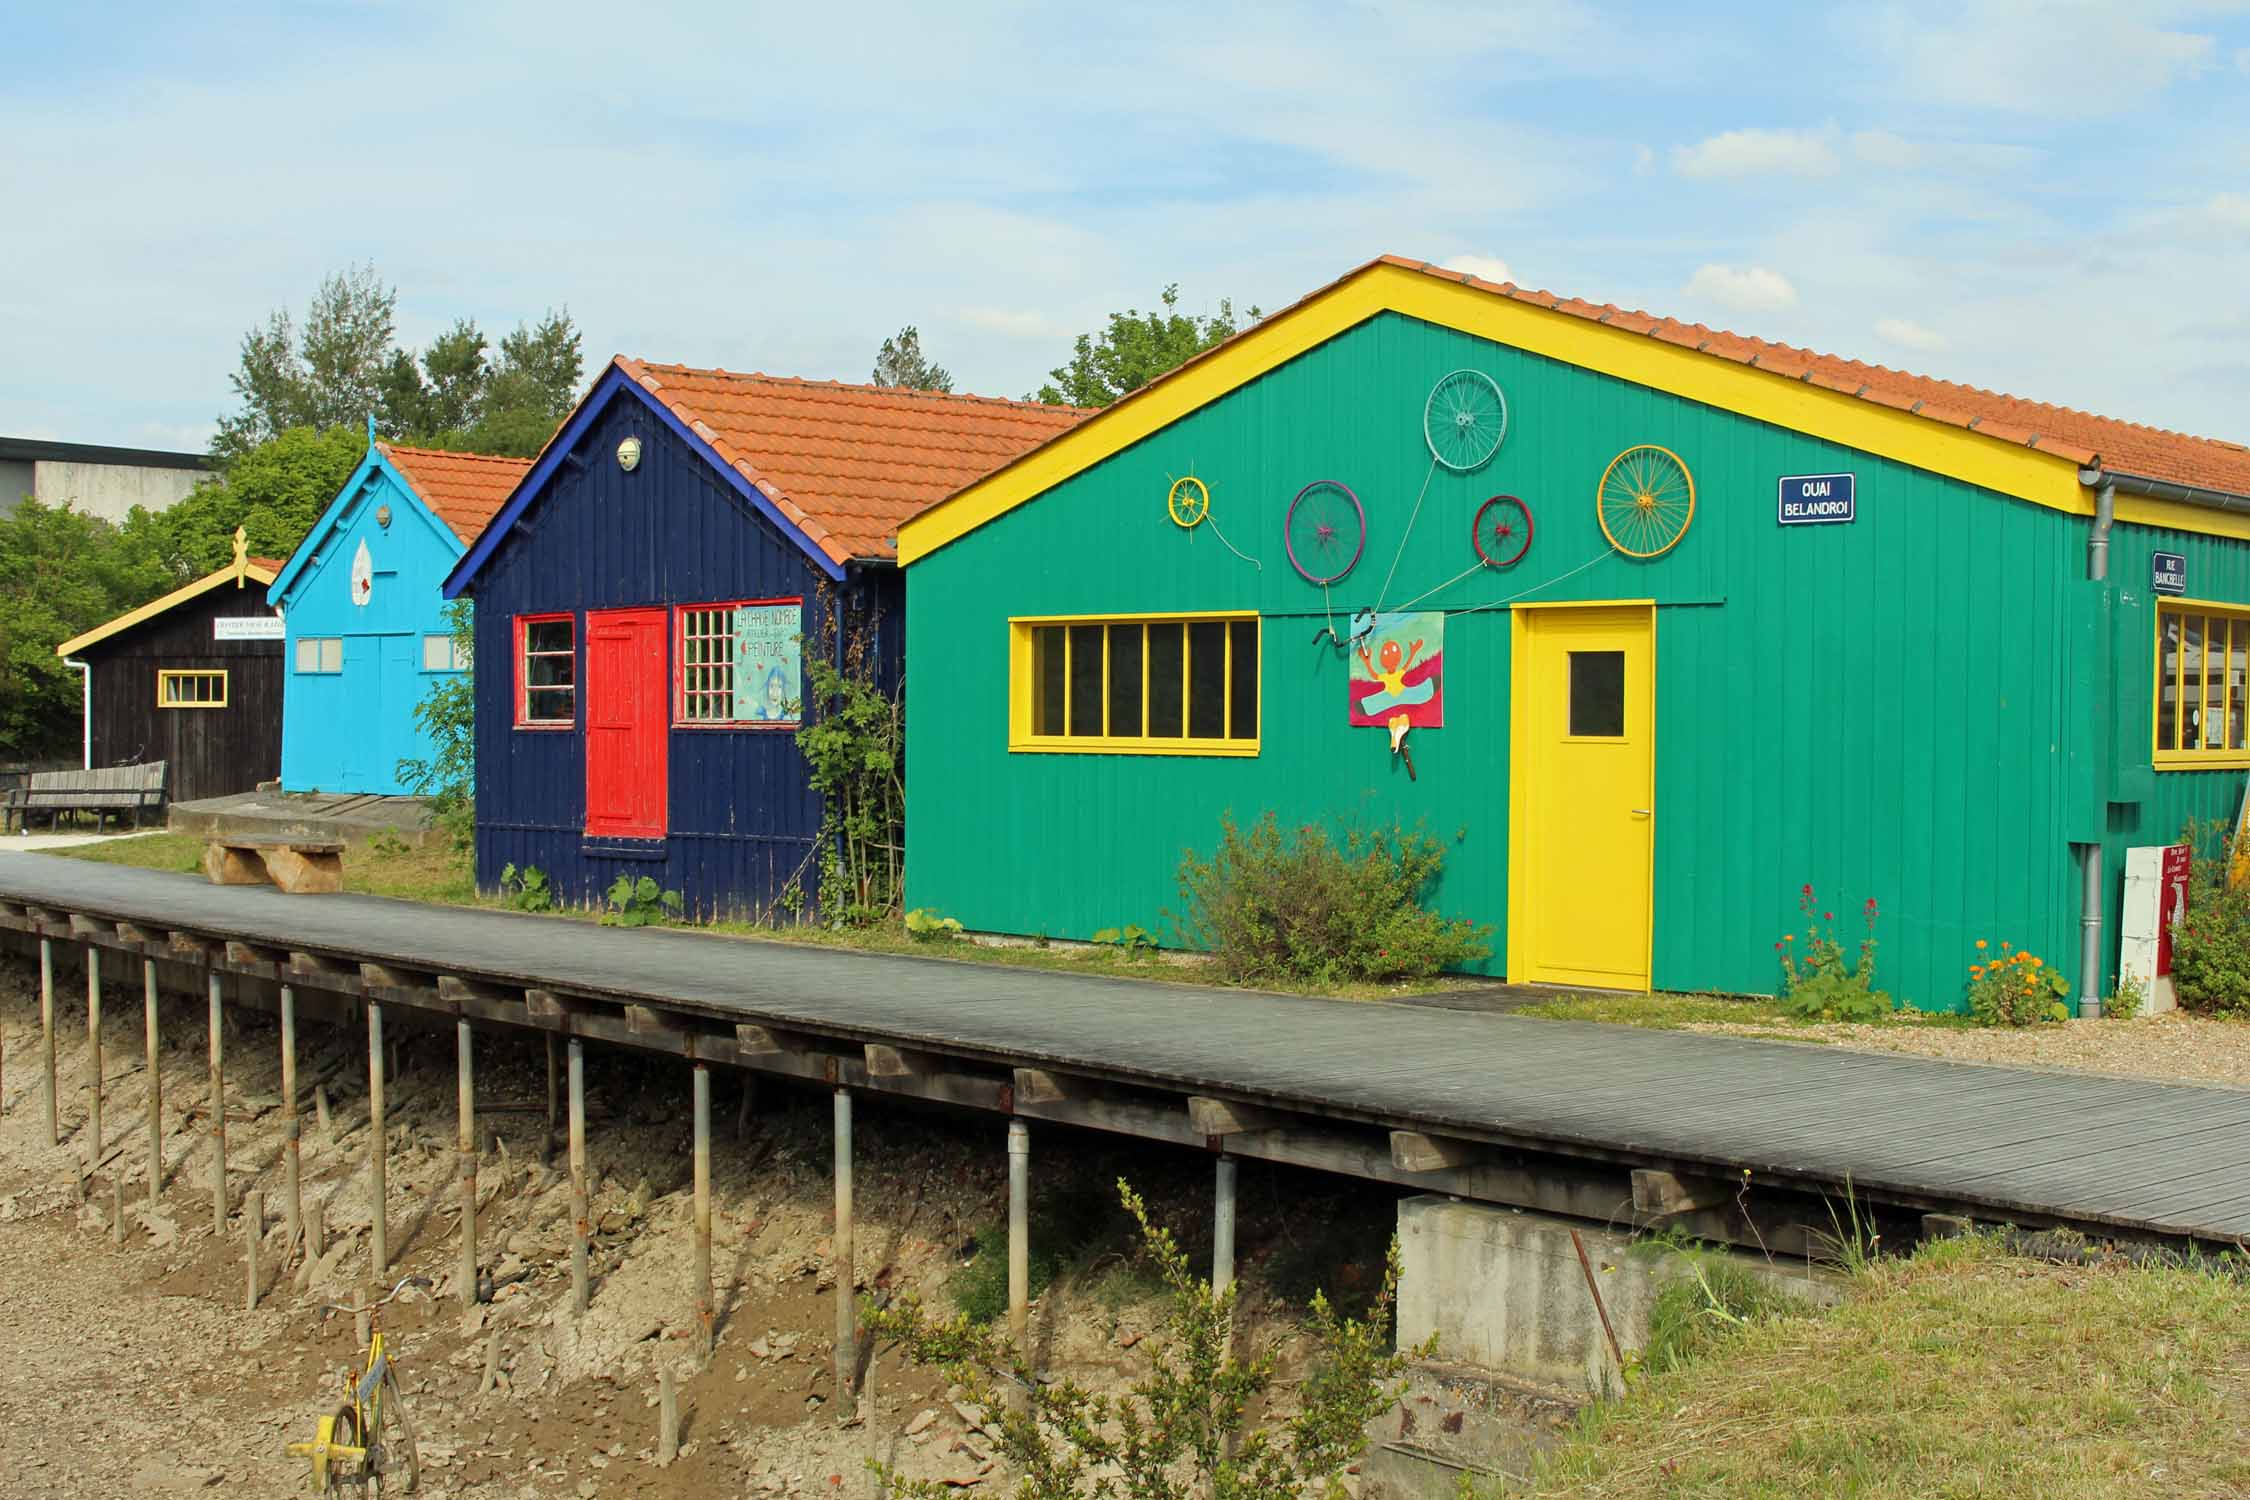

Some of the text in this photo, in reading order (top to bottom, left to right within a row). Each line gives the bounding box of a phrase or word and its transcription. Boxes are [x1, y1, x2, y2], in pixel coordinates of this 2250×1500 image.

[1802, 481, 1830, 497] QUAI
[1784, 501, 1848, 516] BELANDROI
[2166, 559, 2176, 571] RUE
[747, 641, 784, 657] PEINTURE
